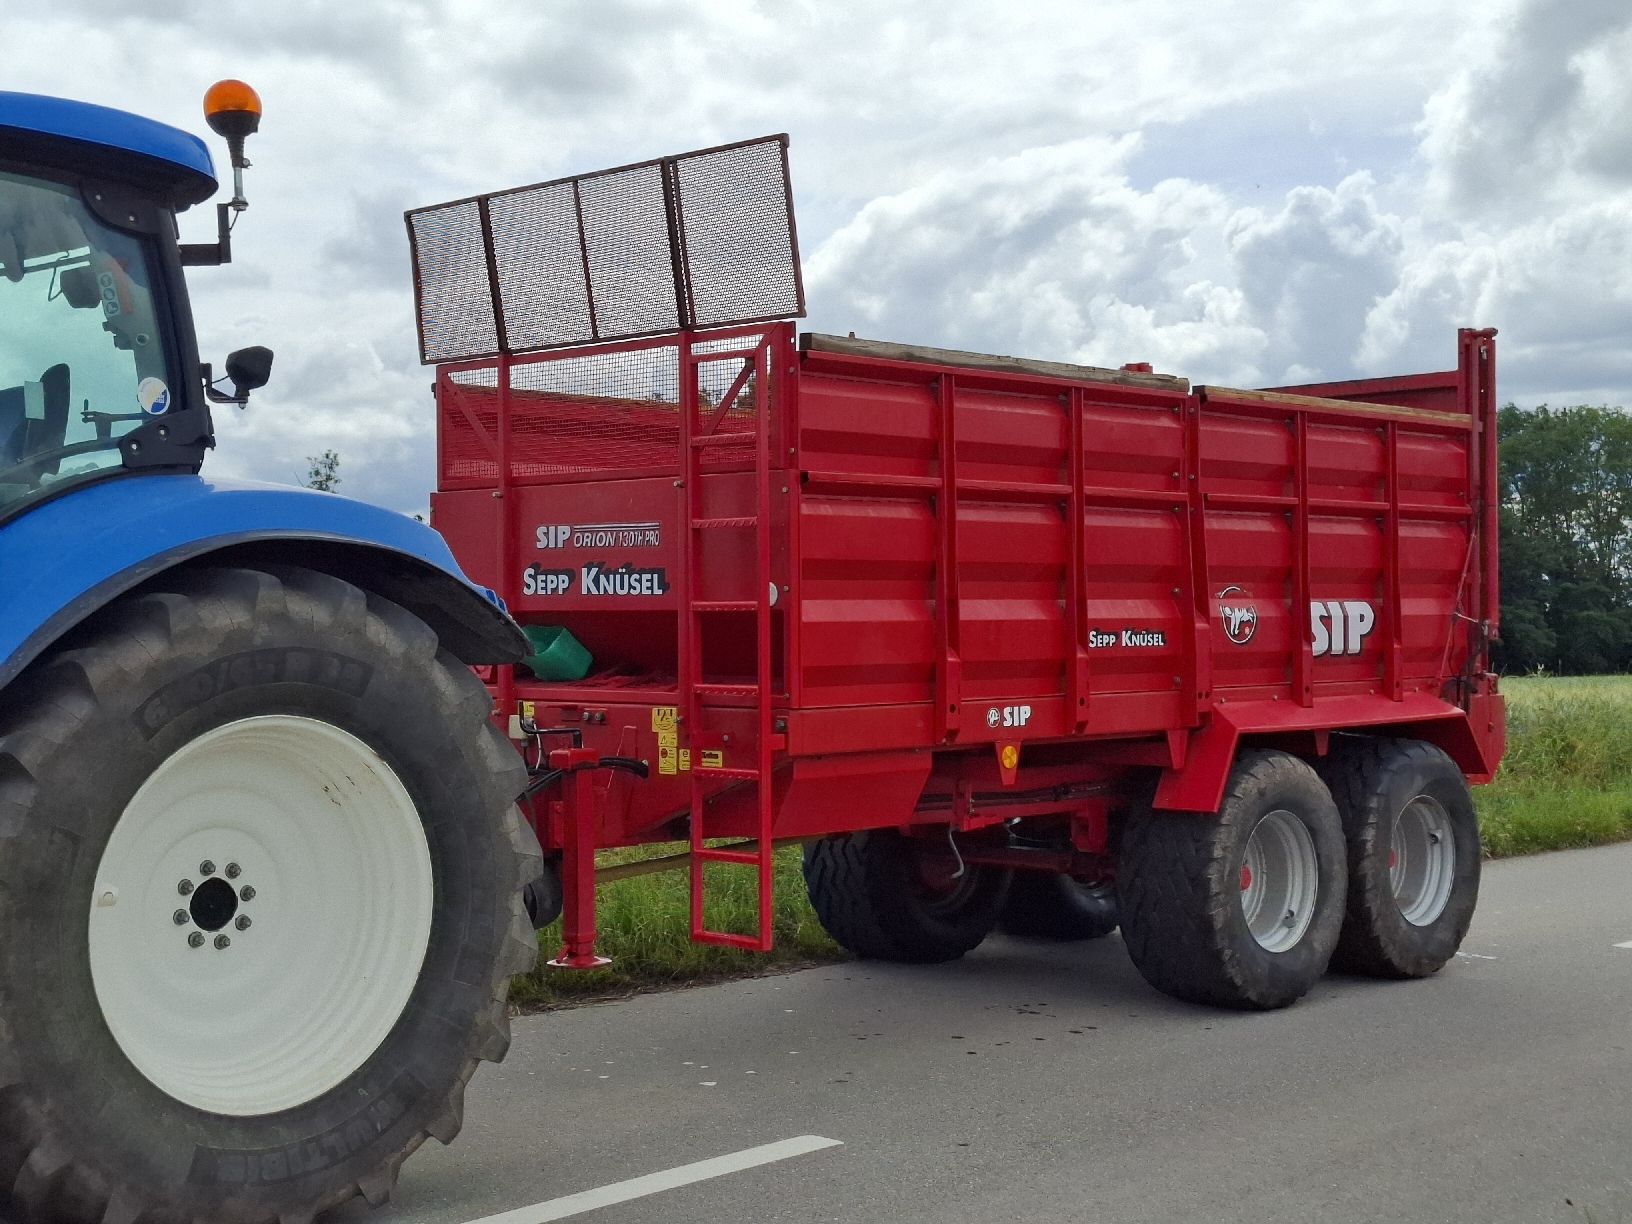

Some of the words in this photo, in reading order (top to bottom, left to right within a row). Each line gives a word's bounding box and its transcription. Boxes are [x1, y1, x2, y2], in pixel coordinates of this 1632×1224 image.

[536, 525, 571, 549] SIP
[573, 532, 617, 548] ORION
[645, 530, 660, 547] PRO
[1310, 601, 1375, 657] SIP
[1003, 705, 1032, 727] SIP
